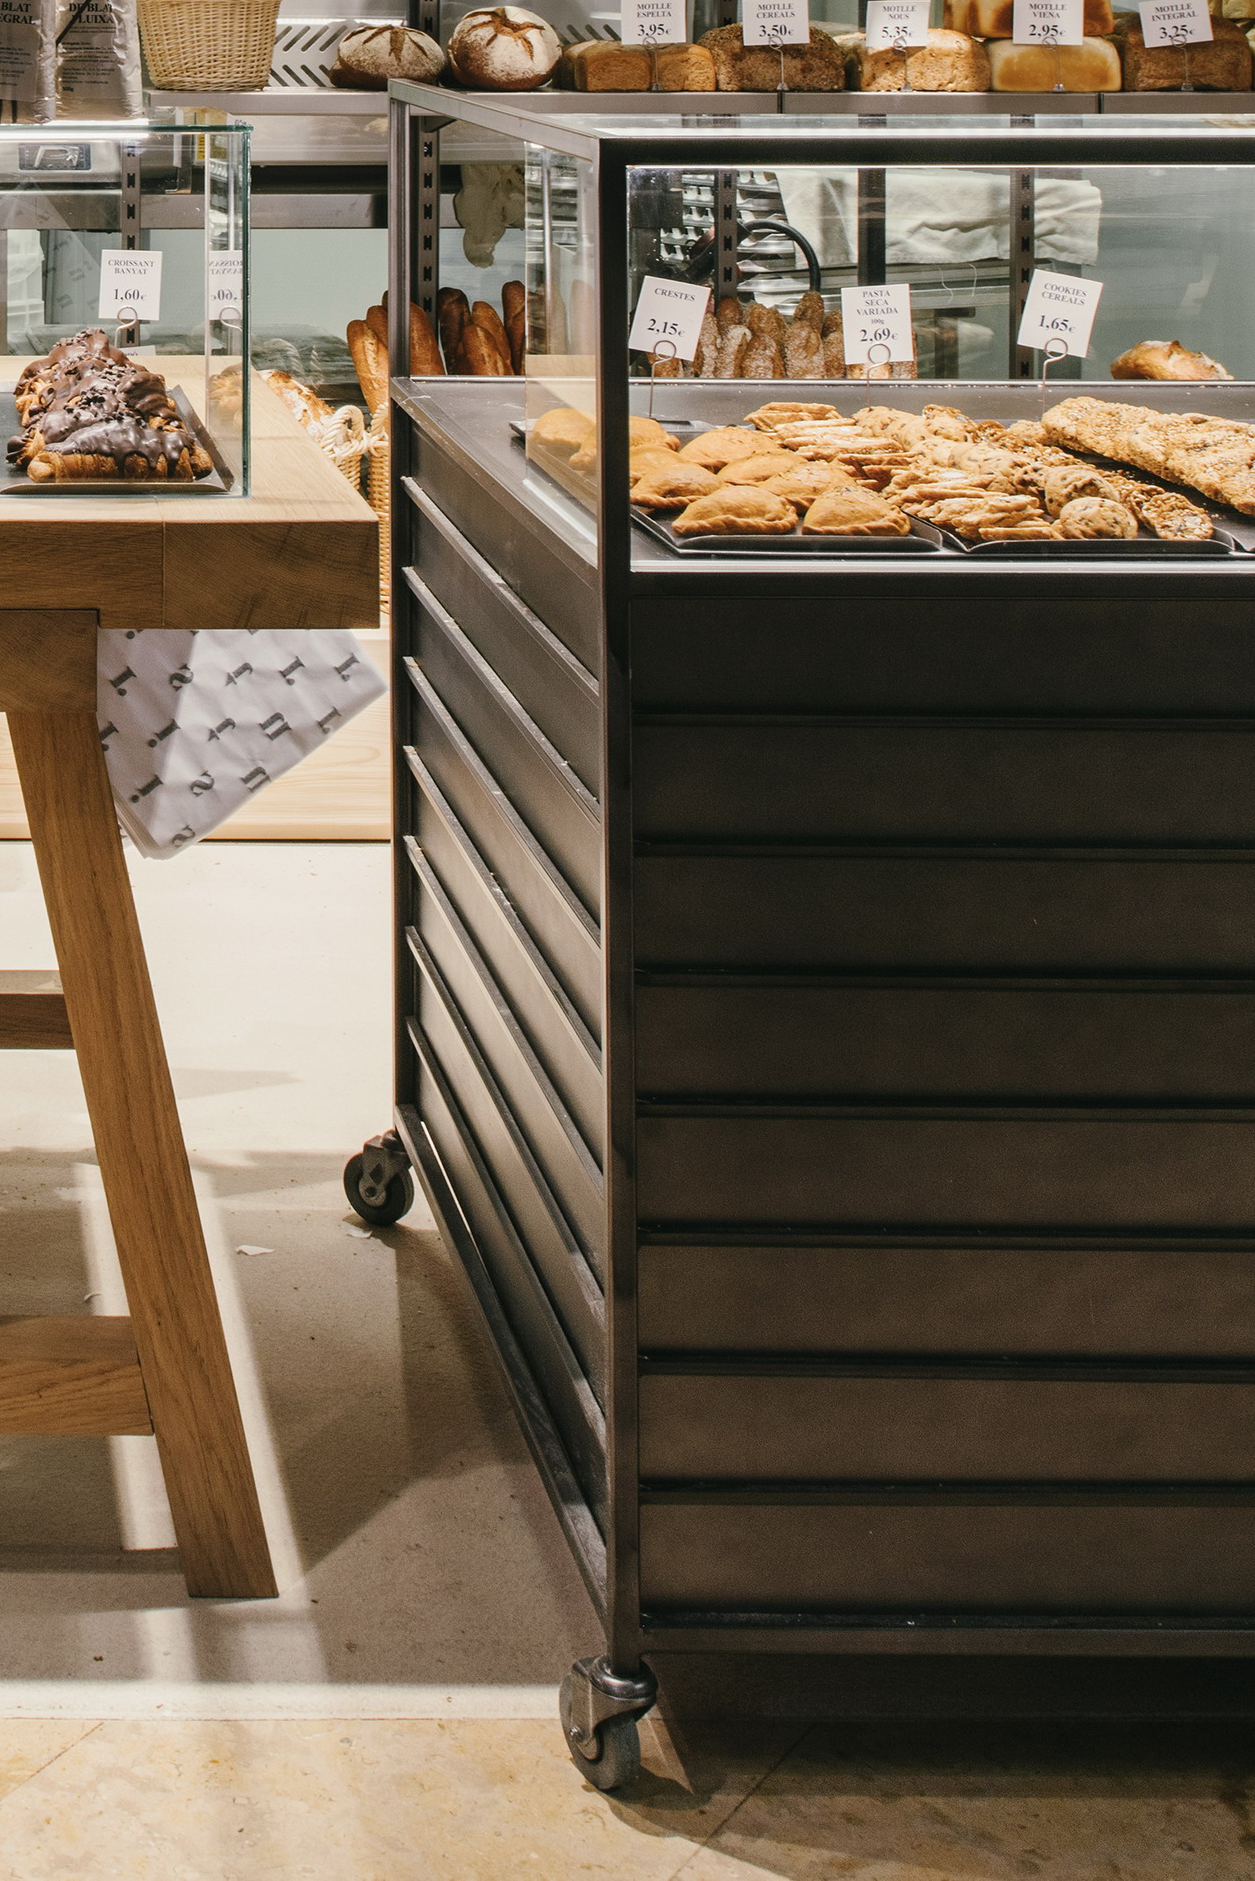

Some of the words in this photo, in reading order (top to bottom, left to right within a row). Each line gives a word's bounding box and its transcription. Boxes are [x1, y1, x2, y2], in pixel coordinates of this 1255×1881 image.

[1, 1, 31, 13] BLAT
[637, 2, 672, 10] MOTLLE
[758, 2, 794, 10] MOTLLE
[1029, 3, 1067, 11] MOTLLE
[1155, 2, 1193, 13] MOTLLE
[637, 10, 672, 18] ESPELTA
[756, 11, 796, 19] CEREALS
[1033, 11, 1061, 19] VIENA
[1152, 10, 1198, 22] INTEGRAL
[637, 23, 671, 37] 3,95€
[759, 24, 794, 37] 3,50€
[882, 26, 914, 38] 5,35€
[1029, 24, 1066, 38] 2,95€
[1159, 25, 1195, 39] 3,25€
[108, 259, 155, 268] CROISSANT
[114, 267, 148, 275] BANYAT
[114, 288, 148, 302] 1,60€
[655, 287, 696, 301] CRESTES
[862, 290, 891, 298] PASTA
[1044, 282, 1088, 297] COOKIES
[865, 299, 889, 307] SECA
[1041, 291, 1086, 306] CEREALS
[856, 307, 899, 316] VARIADA
[647, 318, 686, 338] 2,15€
[1039, 314, 1077, 334] 1,65€
[860, 327, 898, 343] 2,69€
